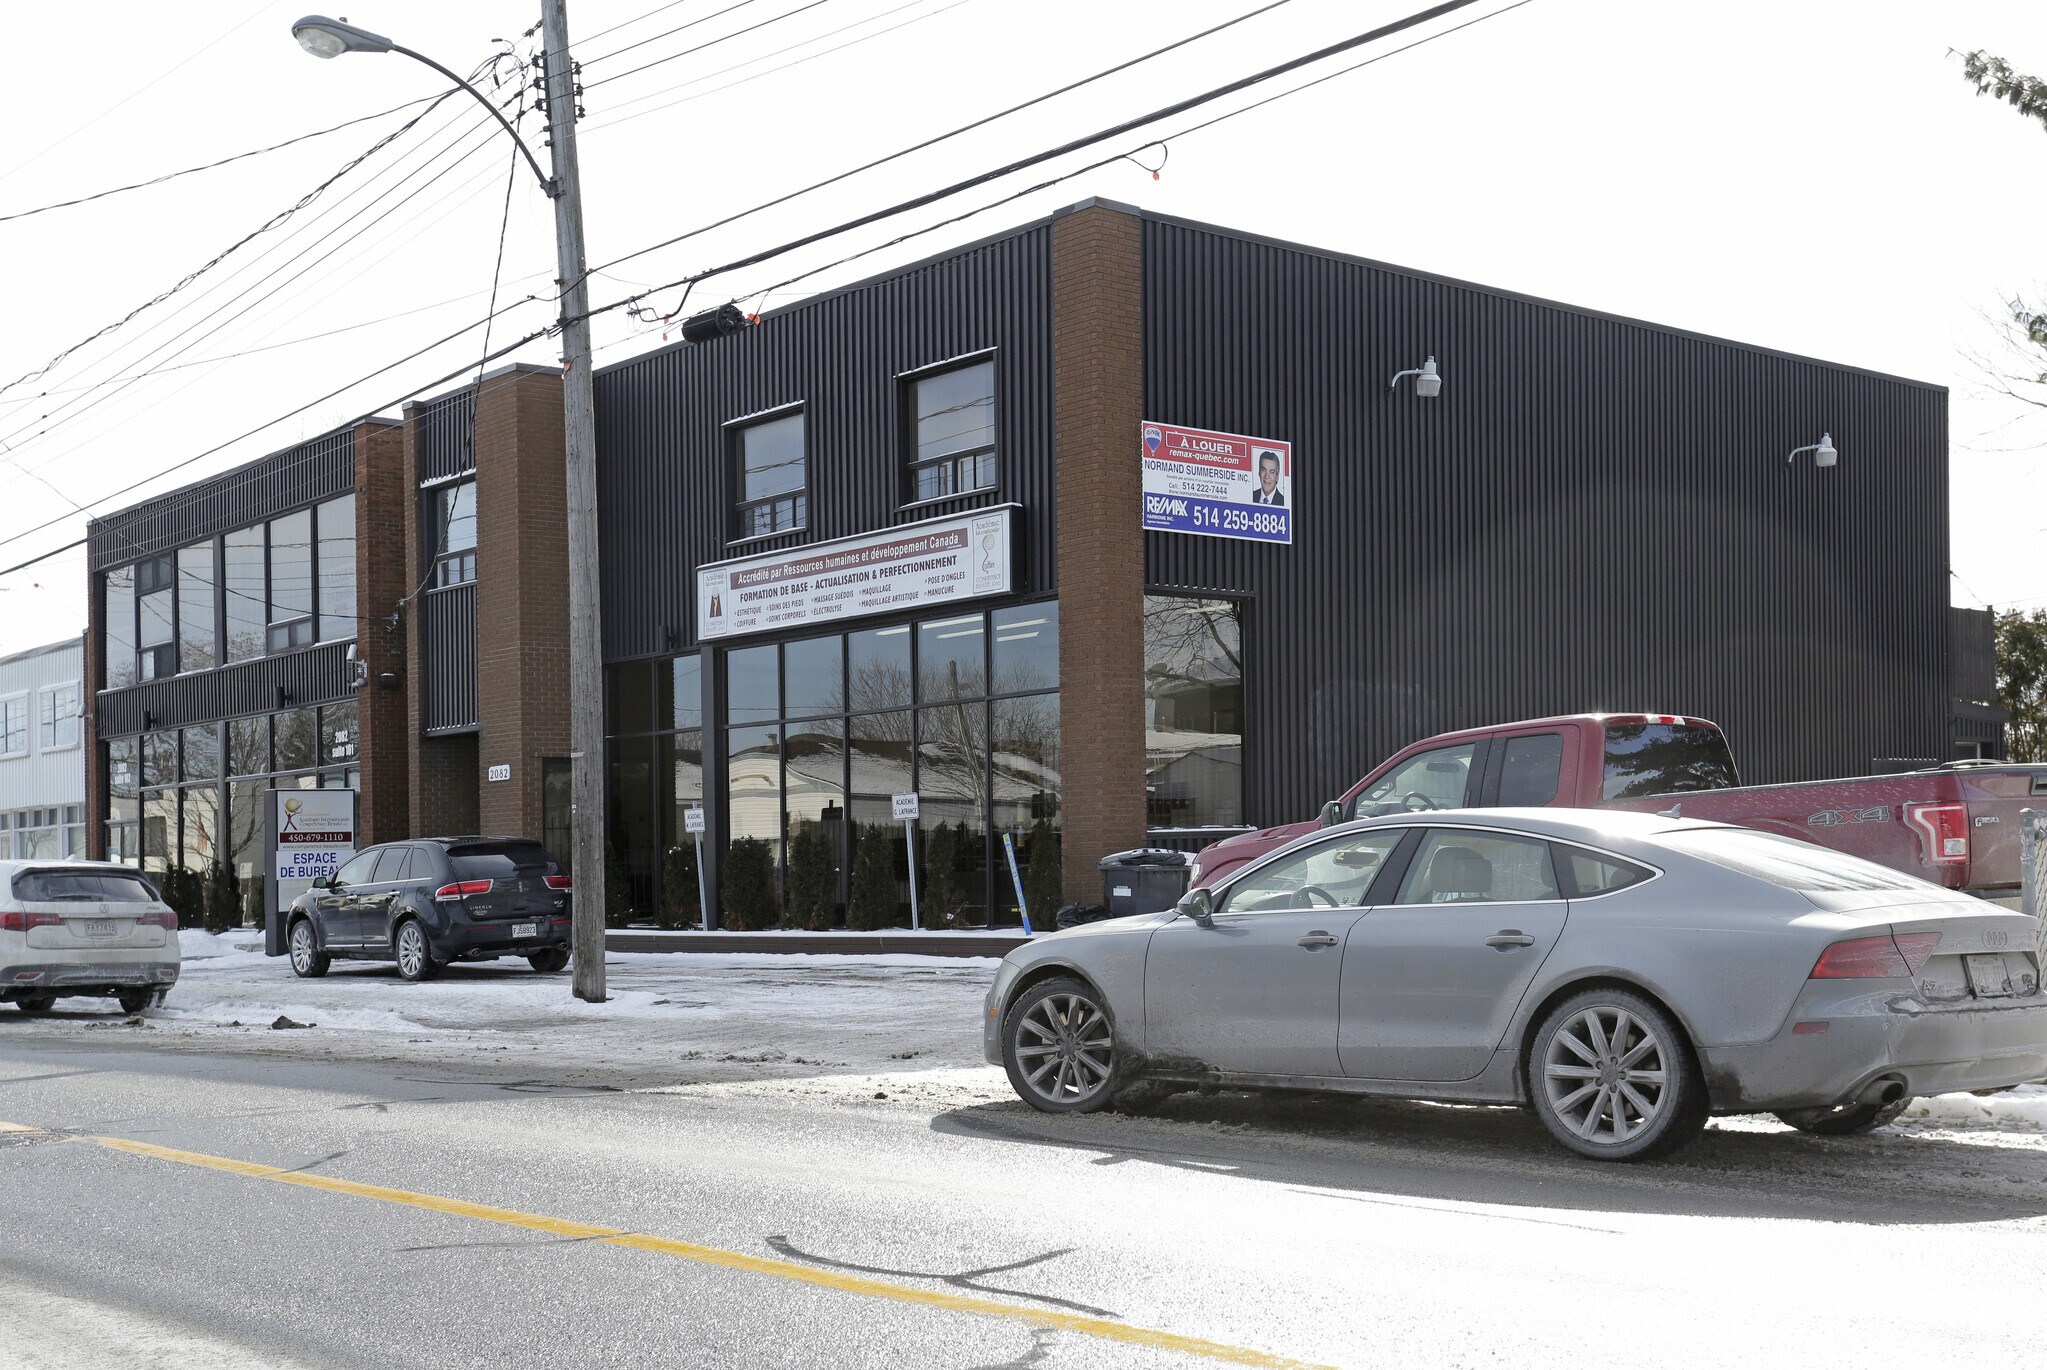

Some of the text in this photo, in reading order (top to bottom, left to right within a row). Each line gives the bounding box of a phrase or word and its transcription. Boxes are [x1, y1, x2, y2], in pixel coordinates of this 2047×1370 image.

[1181, 436, 1233, 454] À LOUER
[1169, 449, 1239, 464] remax-quebec.com
[1144, 460, 1250, 483] NORMAND SUMMERSIDE INC.
[1182, 482, 1195, 491] 514
[1197, 484, 1228, 494] 222-7444
[1146, 495, 1188, 516] RE/MAX
[1193, 505, 1287, 535] 514 259-8884
[738, 569, 769, 585] Accrédité
[770, 570, 782, 581] par
[783, 561, 824, 577] Ressources
[825, 553, 859, 571] humaines
[861, 549, 869, 561] et
[870, 539, 928, 560] développement
[929, 533, 959, 549] Canada
[740, 587, 778, 603] FORMATION
[780, 585, 789, 596] DE
[791, 582, 808, 594] BASE
[815, 570, 870, 590] ACTUALISATION
[871, 570, 878, 580] &
[879, 555, 958, 579] PERFECTIONNEMENT
[927, 571, 966, 584] POSE D'ONGLES
[861, 584, 891, 596] MAQUILLAGE
[927, 585, 955, 597] MANUCURE
[813, 590, 854, 604] MASSAGE SUÉDOIS
[861, 591, 919, 608] MAQUILLAGE ARTISTIQUE
[736, 606, 762, 617] ESTHÉTIQUE
[768, 599, 804, 612] SOINS DES PIEDS
[813, 604, 843, 616] ÉLECTROLYSE
[736, 618, 757, 628] COIFFURE
[768, 610, 807, 623] SOINS CORPORELS
[489, 768, 509, 780] 2082
[898, 807, 917, 816] LAFRANCE
[288, 833, 344, 842] 450-679-1110
[293, 852, 337, 864] ESPACE
[280, 865, 339, 878] DE BUREA
[1922, 979, 1937, 992] A7
